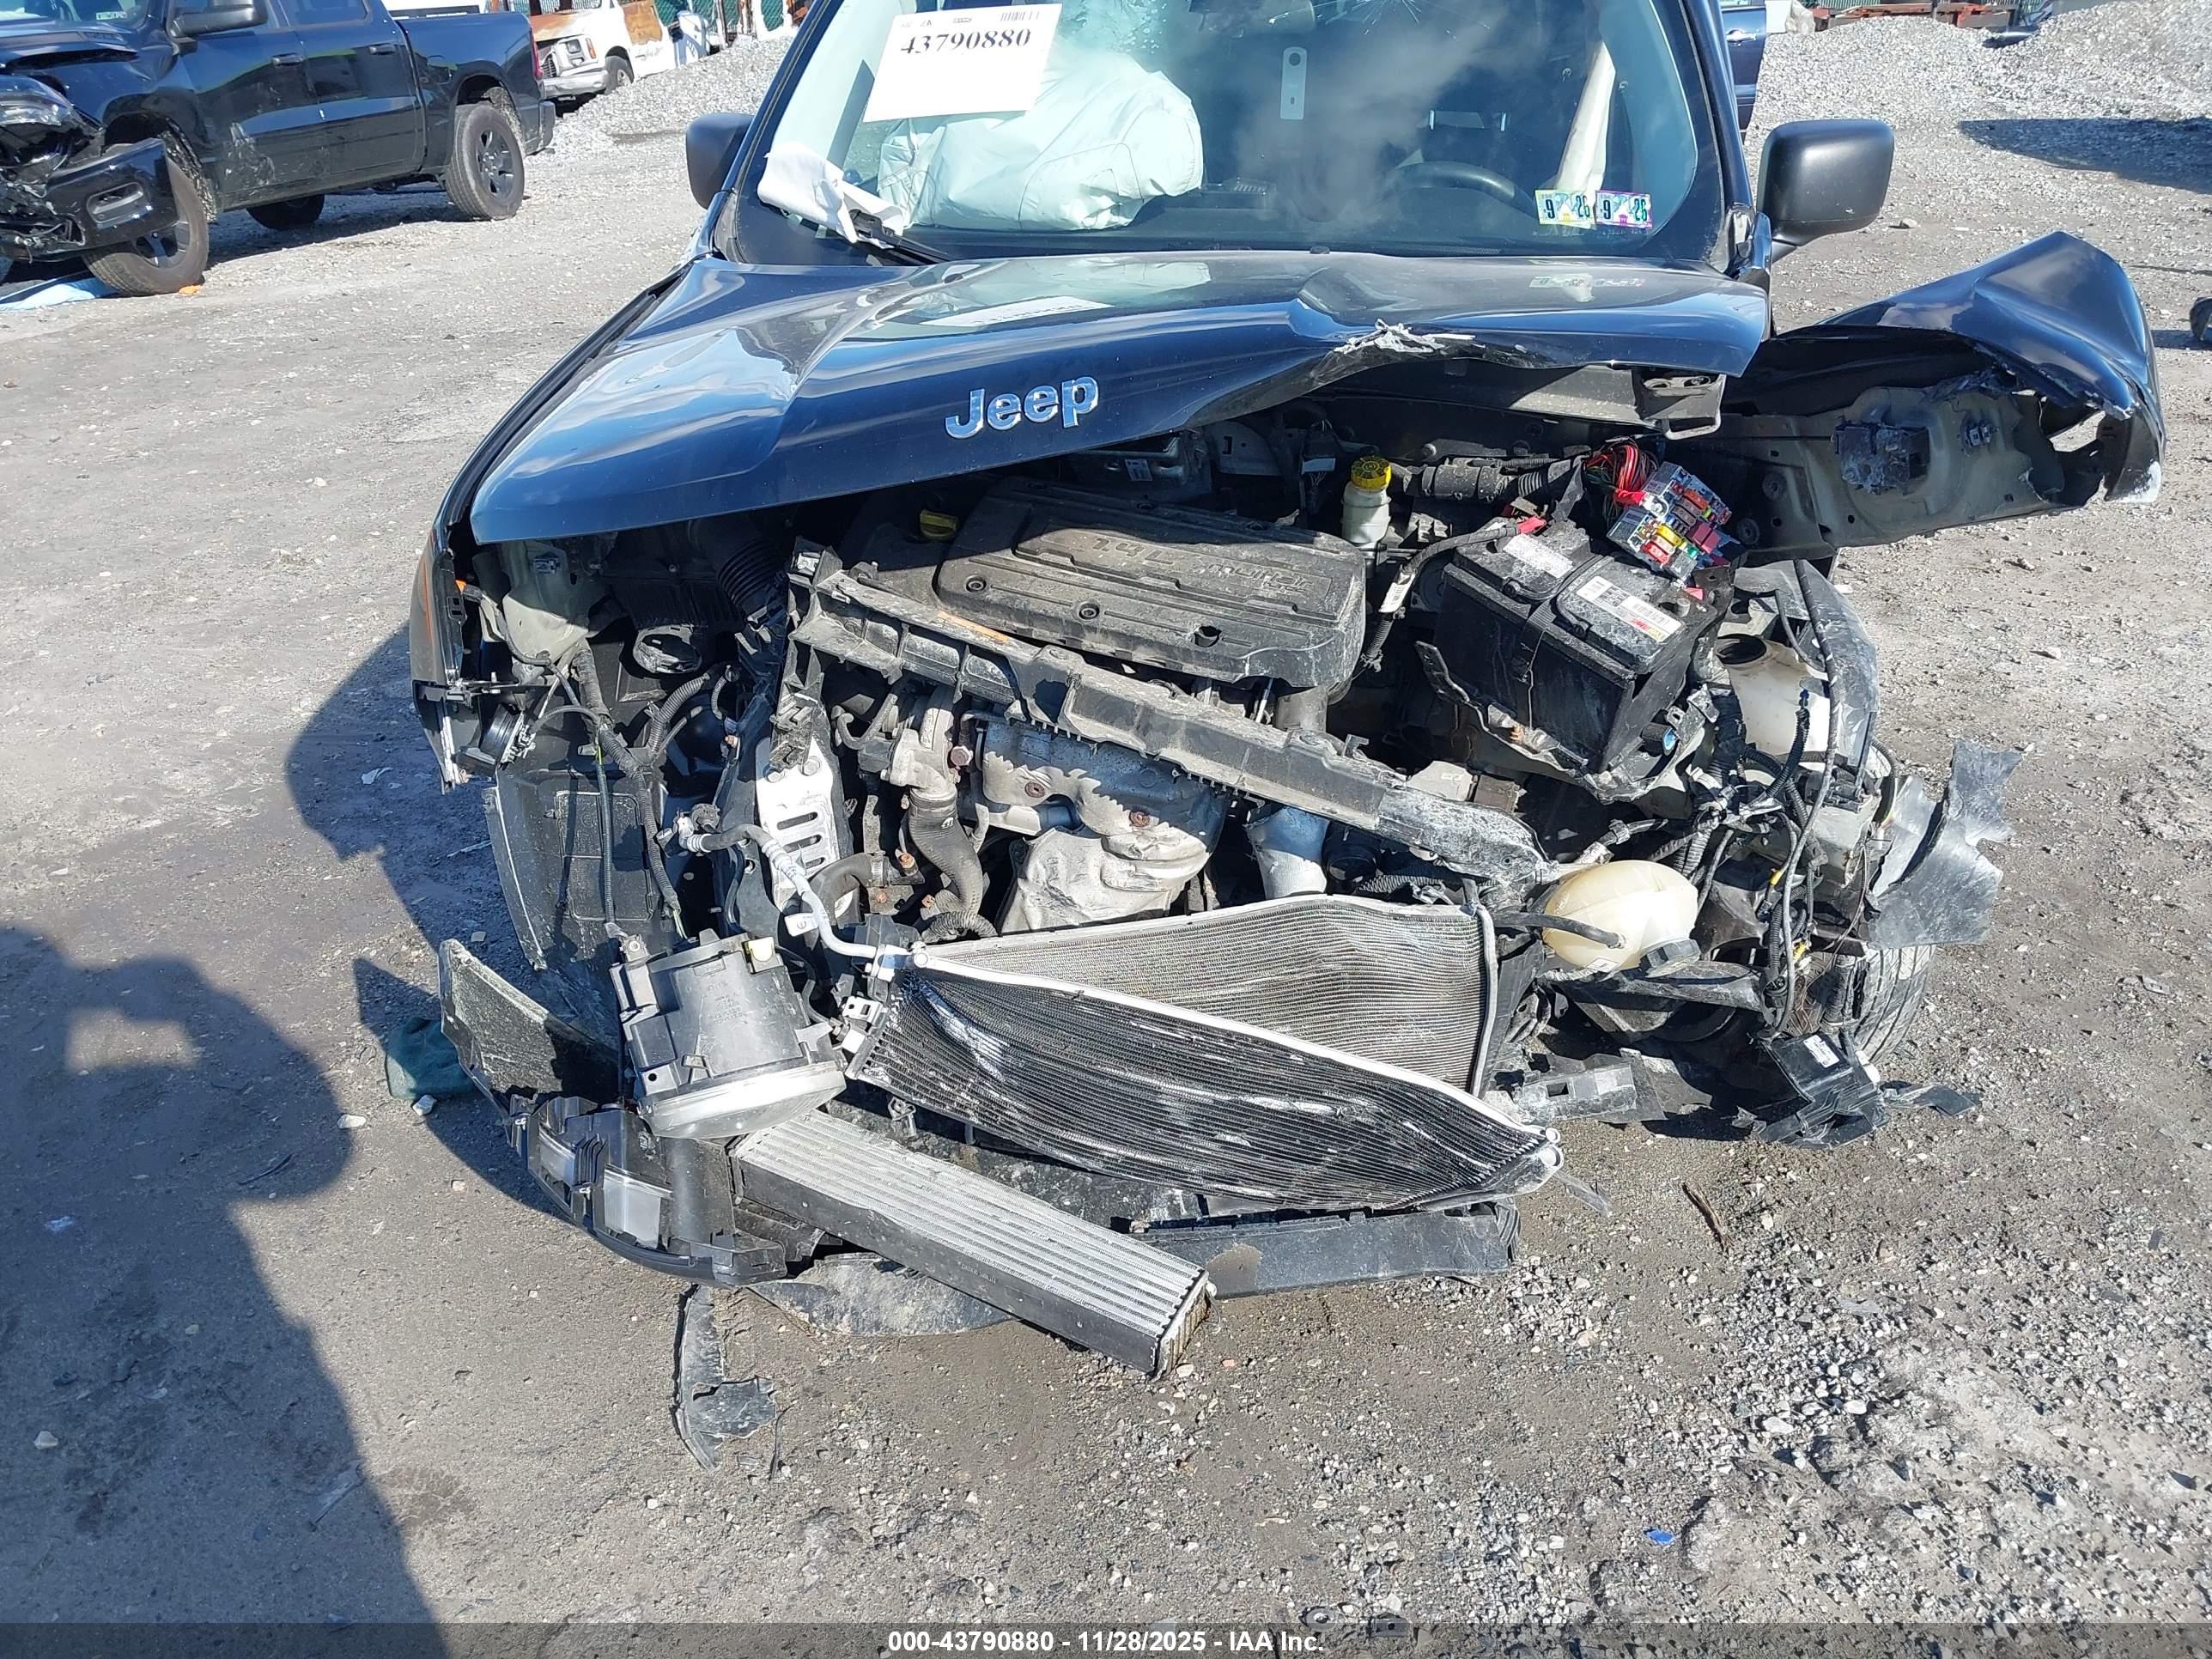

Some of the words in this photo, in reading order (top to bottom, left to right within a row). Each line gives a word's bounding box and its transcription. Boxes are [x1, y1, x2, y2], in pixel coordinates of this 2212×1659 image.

[900, 28, 1031, 54] 43790880
[1545, 198, 1556, 220] 9
[1575, 195, 1590, 218] 26
[1602, 199, 1611, 220] 9
[1633, 198, 1648, 222] 26
[945, 376, 1099, 439] Jeep
